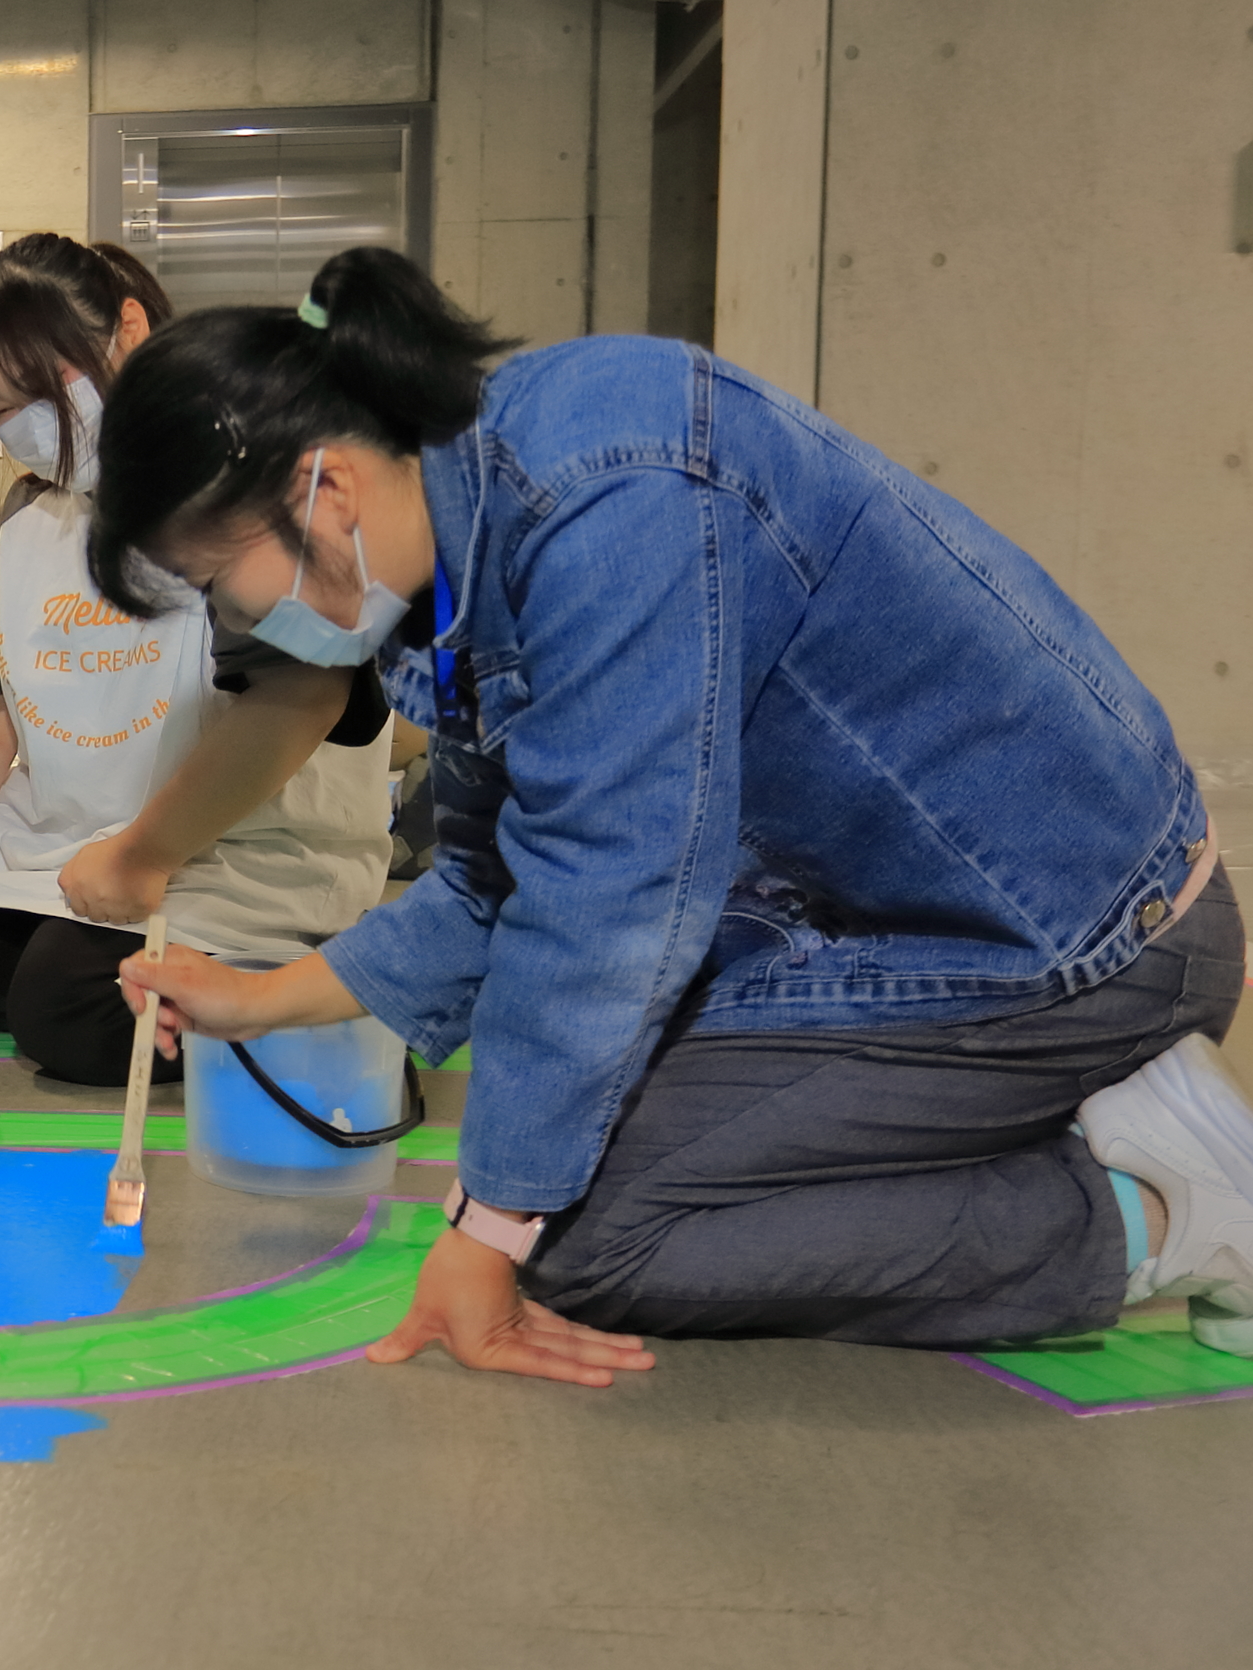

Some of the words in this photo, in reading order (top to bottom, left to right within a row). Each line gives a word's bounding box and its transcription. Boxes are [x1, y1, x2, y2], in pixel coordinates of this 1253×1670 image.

[34, 650, 72, 672] ICE
[79, 640, 161, 673] CREAMS
[16, 696, 45, 728] like
[46, 720, 73, 742] ice
[76, 729, 130, 748] cream
[132, 717, 152, 733] in
